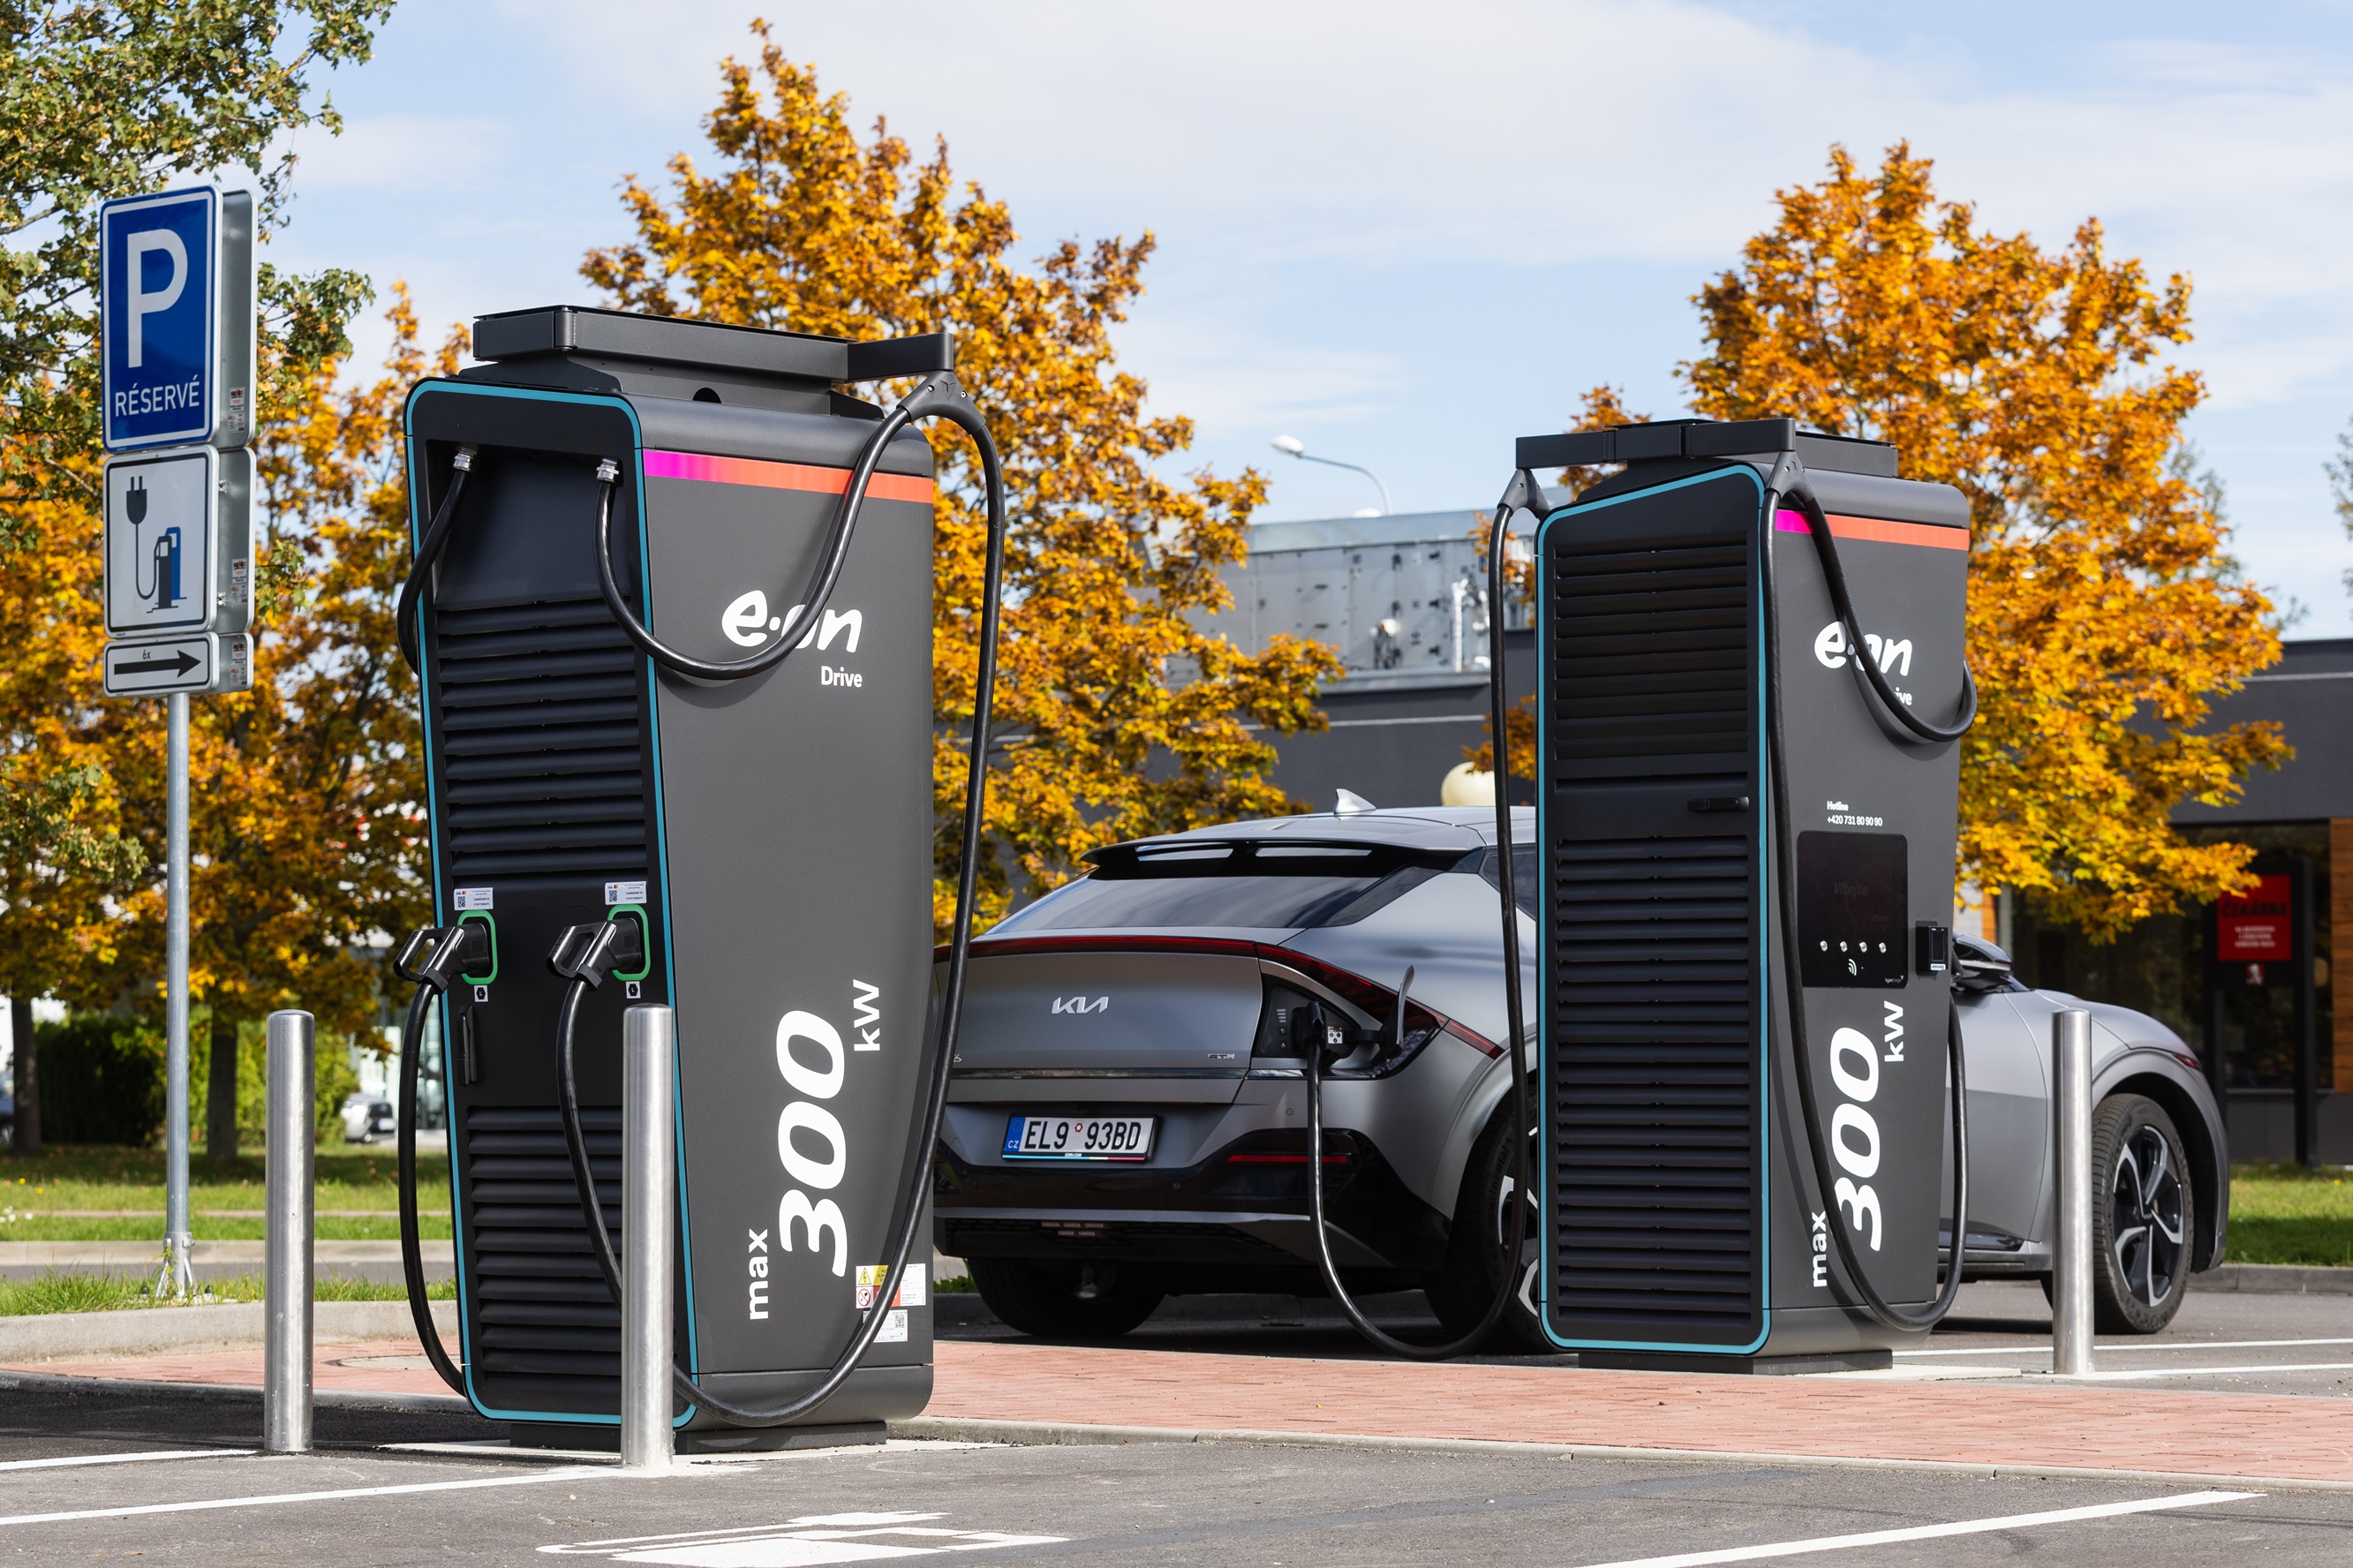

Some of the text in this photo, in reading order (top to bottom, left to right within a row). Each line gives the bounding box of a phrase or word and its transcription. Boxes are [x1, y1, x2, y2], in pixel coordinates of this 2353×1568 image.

[127, 229, 188, 368] P
[115, 374, 200, 417] RÉSERVÉ
[142, 649, 151, 660] 6x
[821, 666, 863, 688] Drive
[1827, 815, 1883, 827] +420 731 80 90 90
[853, 979, 881, 1052] kW
[1052, 997, 1109, 1014] KIA
[1883, 1000, 1904, 1063] kW
[775, 1010, 848, 1278] 300
[1007, 1140, 1019, 1149] CZ
[1024, 1121, 1142, 1150] EL9 93BD
[1830, 1028, 1882, 1251] 300
[748, 1228, 769, 1321] max
[1812, 1210, 1827, 1287] max
